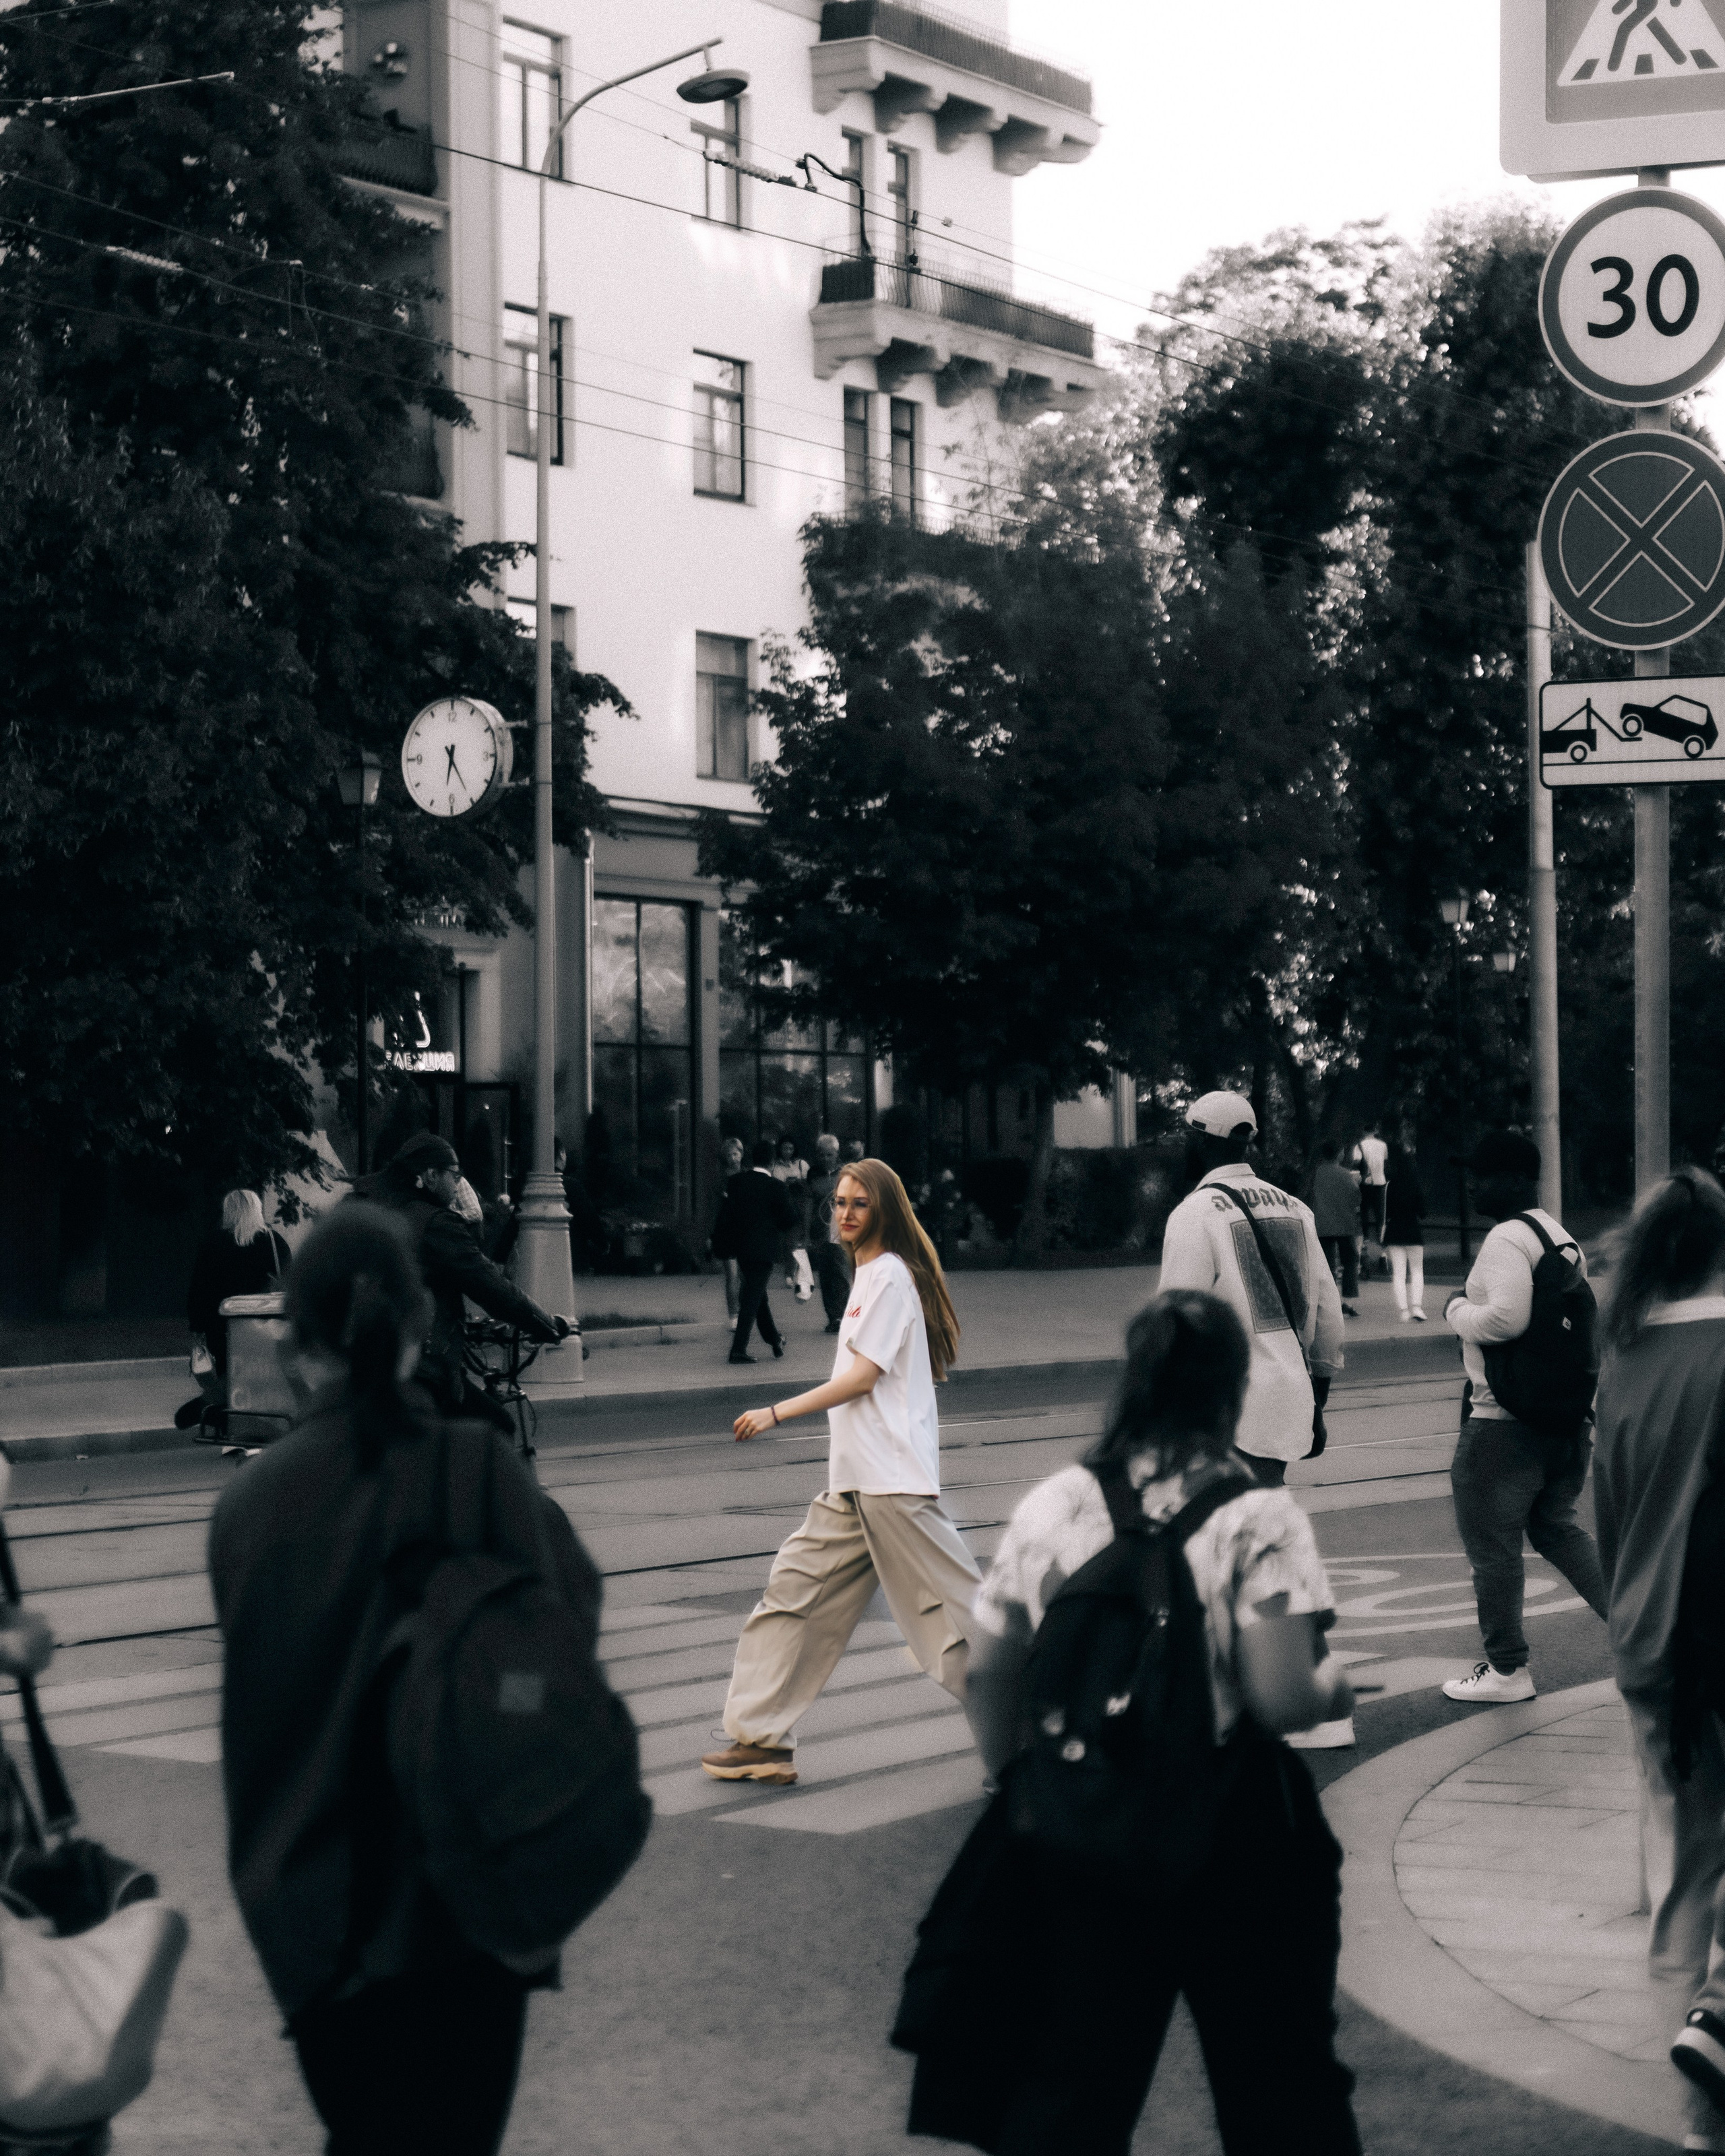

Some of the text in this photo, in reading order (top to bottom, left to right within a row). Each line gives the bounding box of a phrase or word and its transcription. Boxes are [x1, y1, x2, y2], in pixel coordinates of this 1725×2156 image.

[1587, 253, 1700, 339] 30
[447, 711, 457, 723] 12
[416, 754, 422, 765] 9
[482, 751, 489, 761] 3
[449, 794, 455, 804] 6
